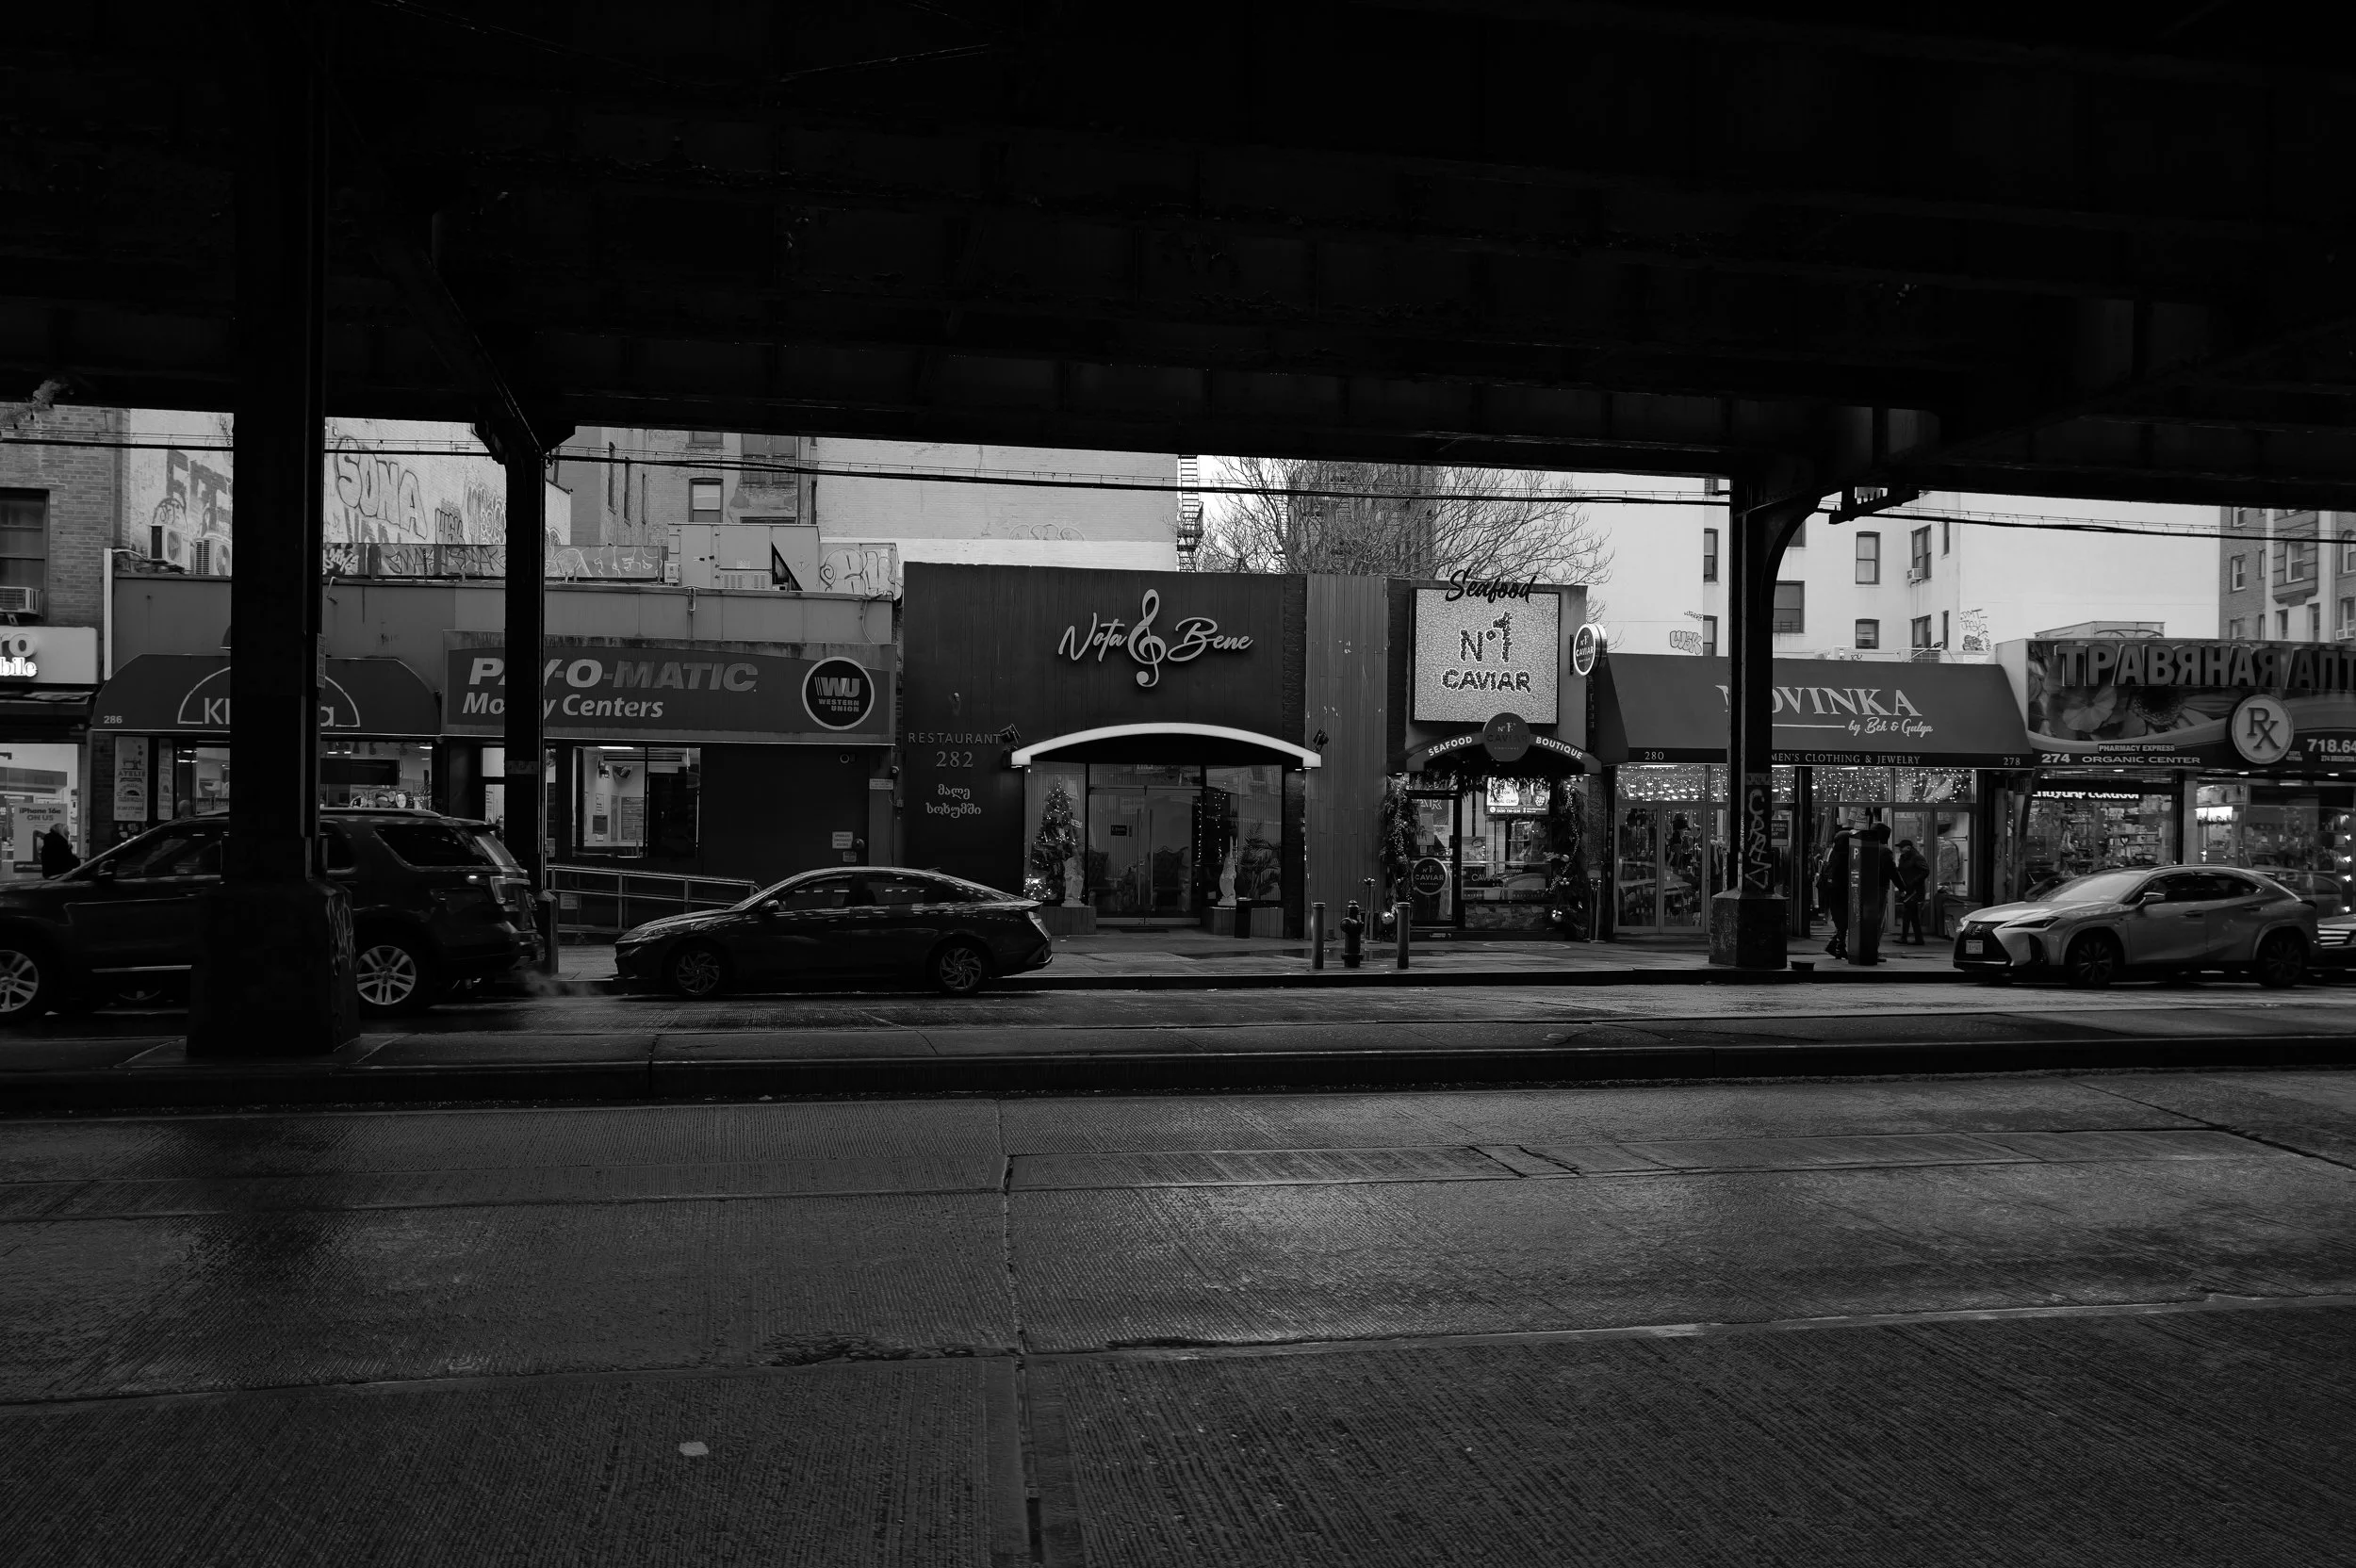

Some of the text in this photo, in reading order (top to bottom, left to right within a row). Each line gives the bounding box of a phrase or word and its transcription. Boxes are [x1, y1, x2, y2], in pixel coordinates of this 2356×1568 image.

[1446, 567, 1537, 603] Seafood
[1057, 612, 1254, 662] Nota Bene
[2054, 644, 2282, 687] ТРАВЯНАЯ
[1441, 668, 1532, 693] CAVIAR
[563, 694, 663, 717] Centers
[104, 715, 123, 724] 286
[1848, 719, 1861, 736] by
[1890, 720, 1899, 731] &
[1901, 718, 1934, 738] Gulya
[908, 733, 1001, 744] RESTAURANT
[1428, 735, 1473, 758] SEAFOOD
[1535, 736, 1583, 760] BOUTIQUE
[1644, 751, 1664, 760] 280
[936, 751, 973, 768] 282
[1805, 754, 1860, 763] CLOTHING
[1865, 755, 1873, 763] &
[1876, 755, 1922, 764] JEWELRY
[2002, 757, 2021, 766] 278
[2041, 754, 2070, 763] 274
[2081, 756, 2201, 764] ORGANIC CENTER
